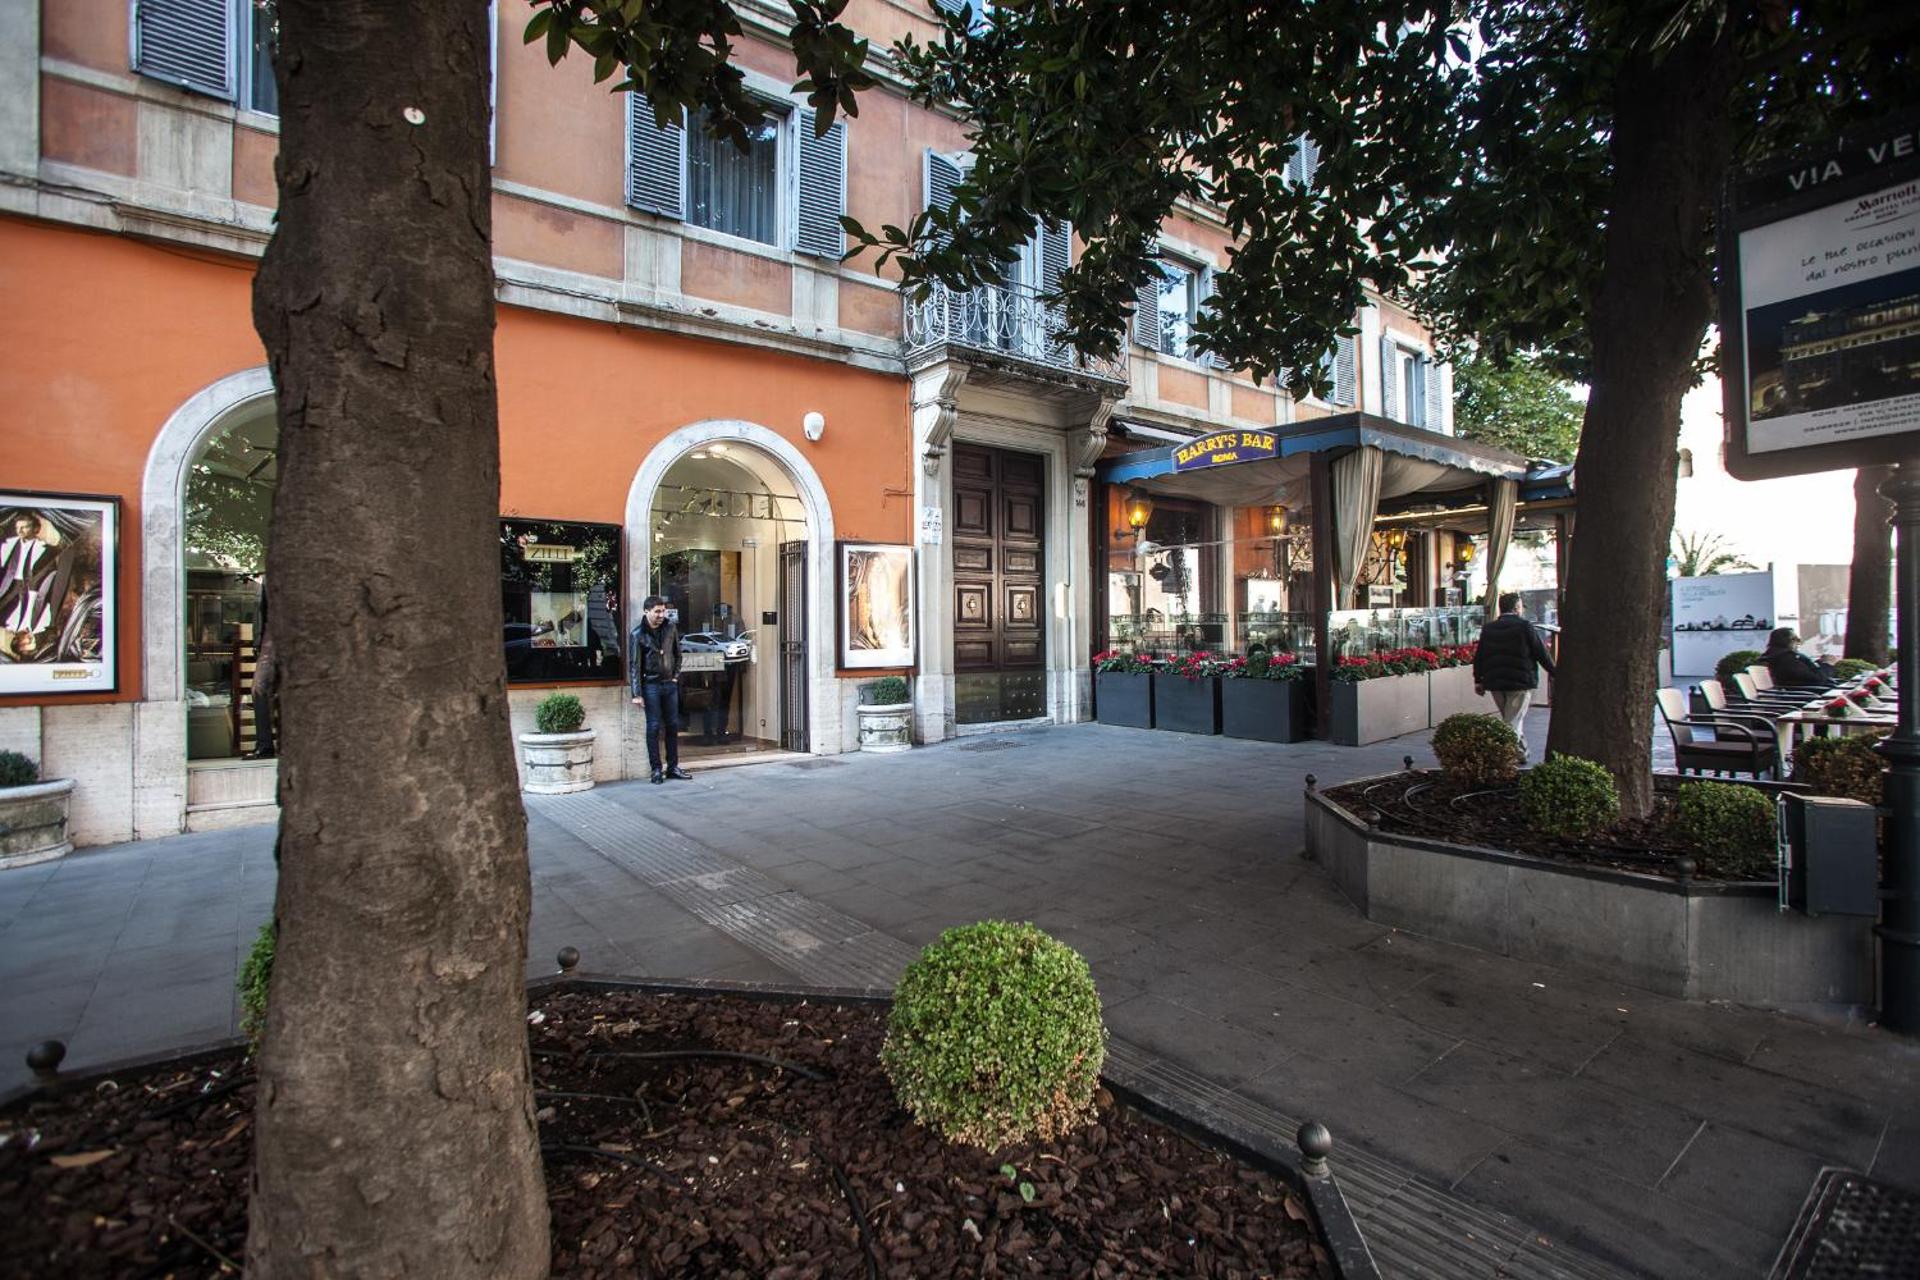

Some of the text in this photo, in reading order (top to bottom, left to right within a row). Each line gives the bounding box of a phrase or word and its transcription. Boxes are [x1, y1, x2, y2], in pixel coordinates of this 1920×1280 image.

[1788, 129, 1920, 191] VIA VE
[1853, 184, 1917, 215] Marriott
[1834, 255, 1878, 274] nostro
[1241, 433, 1274, 450] BAR
